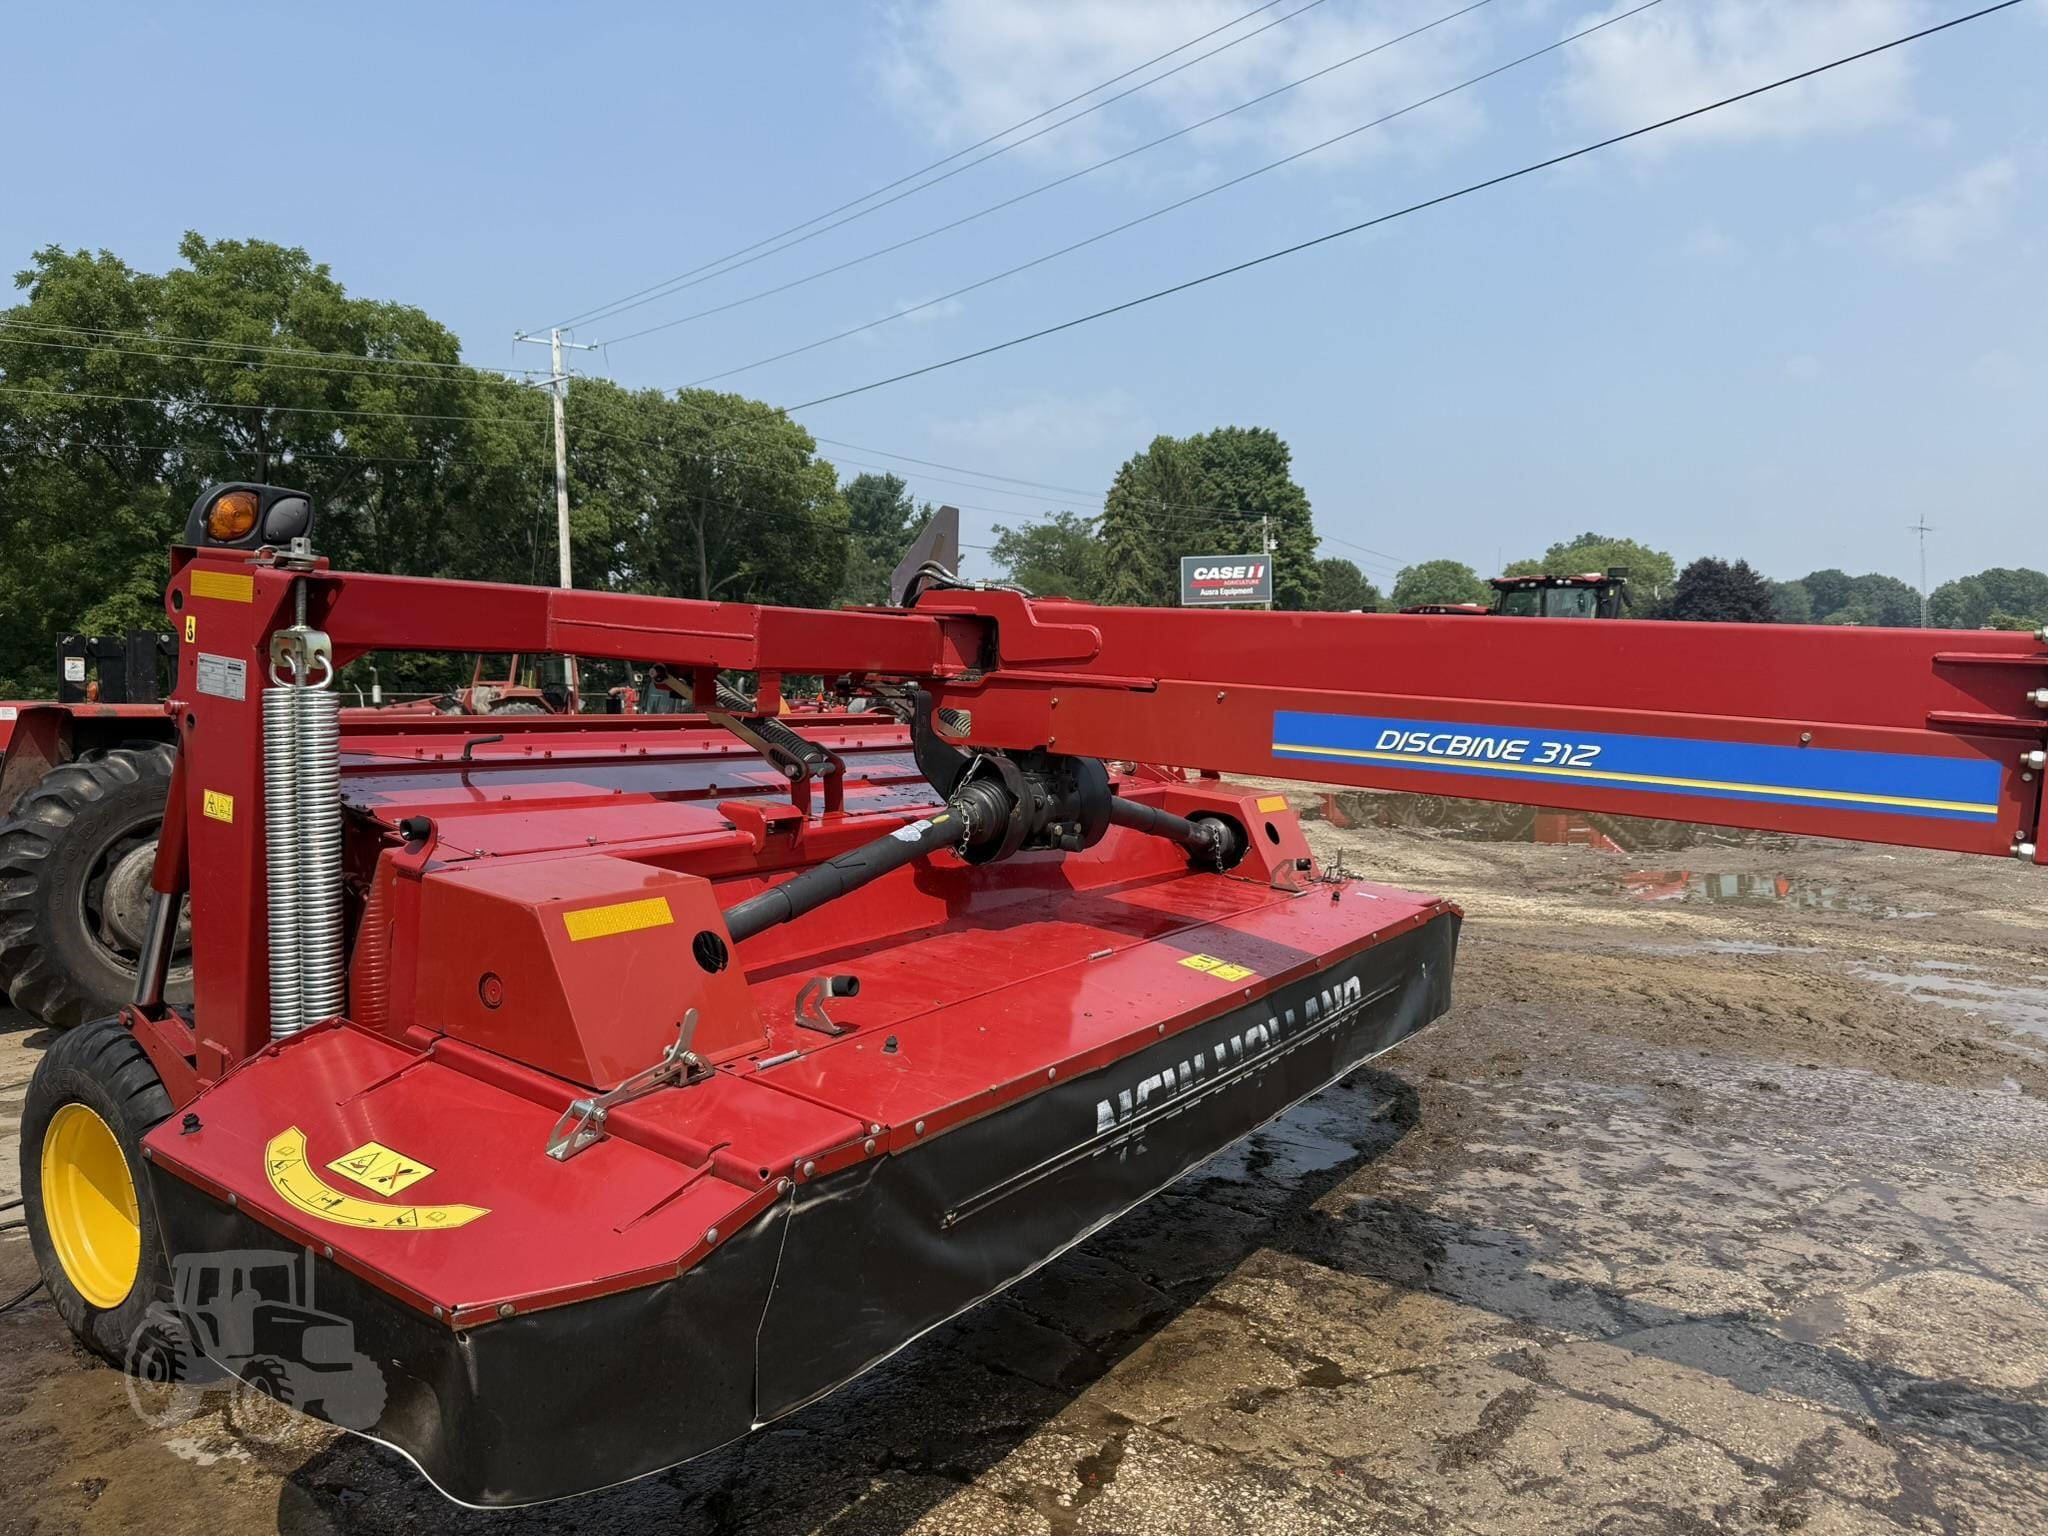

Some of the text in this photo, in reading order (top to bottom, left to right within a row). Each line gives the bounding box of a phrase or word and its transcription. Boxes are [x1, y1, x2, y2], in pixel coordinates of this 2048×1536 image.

[1193, 566, 1246, 581] CASE
[1220, 587, 1254, 596] Equipment
[1375, 730, 1601, 767] DISCBINE 312
